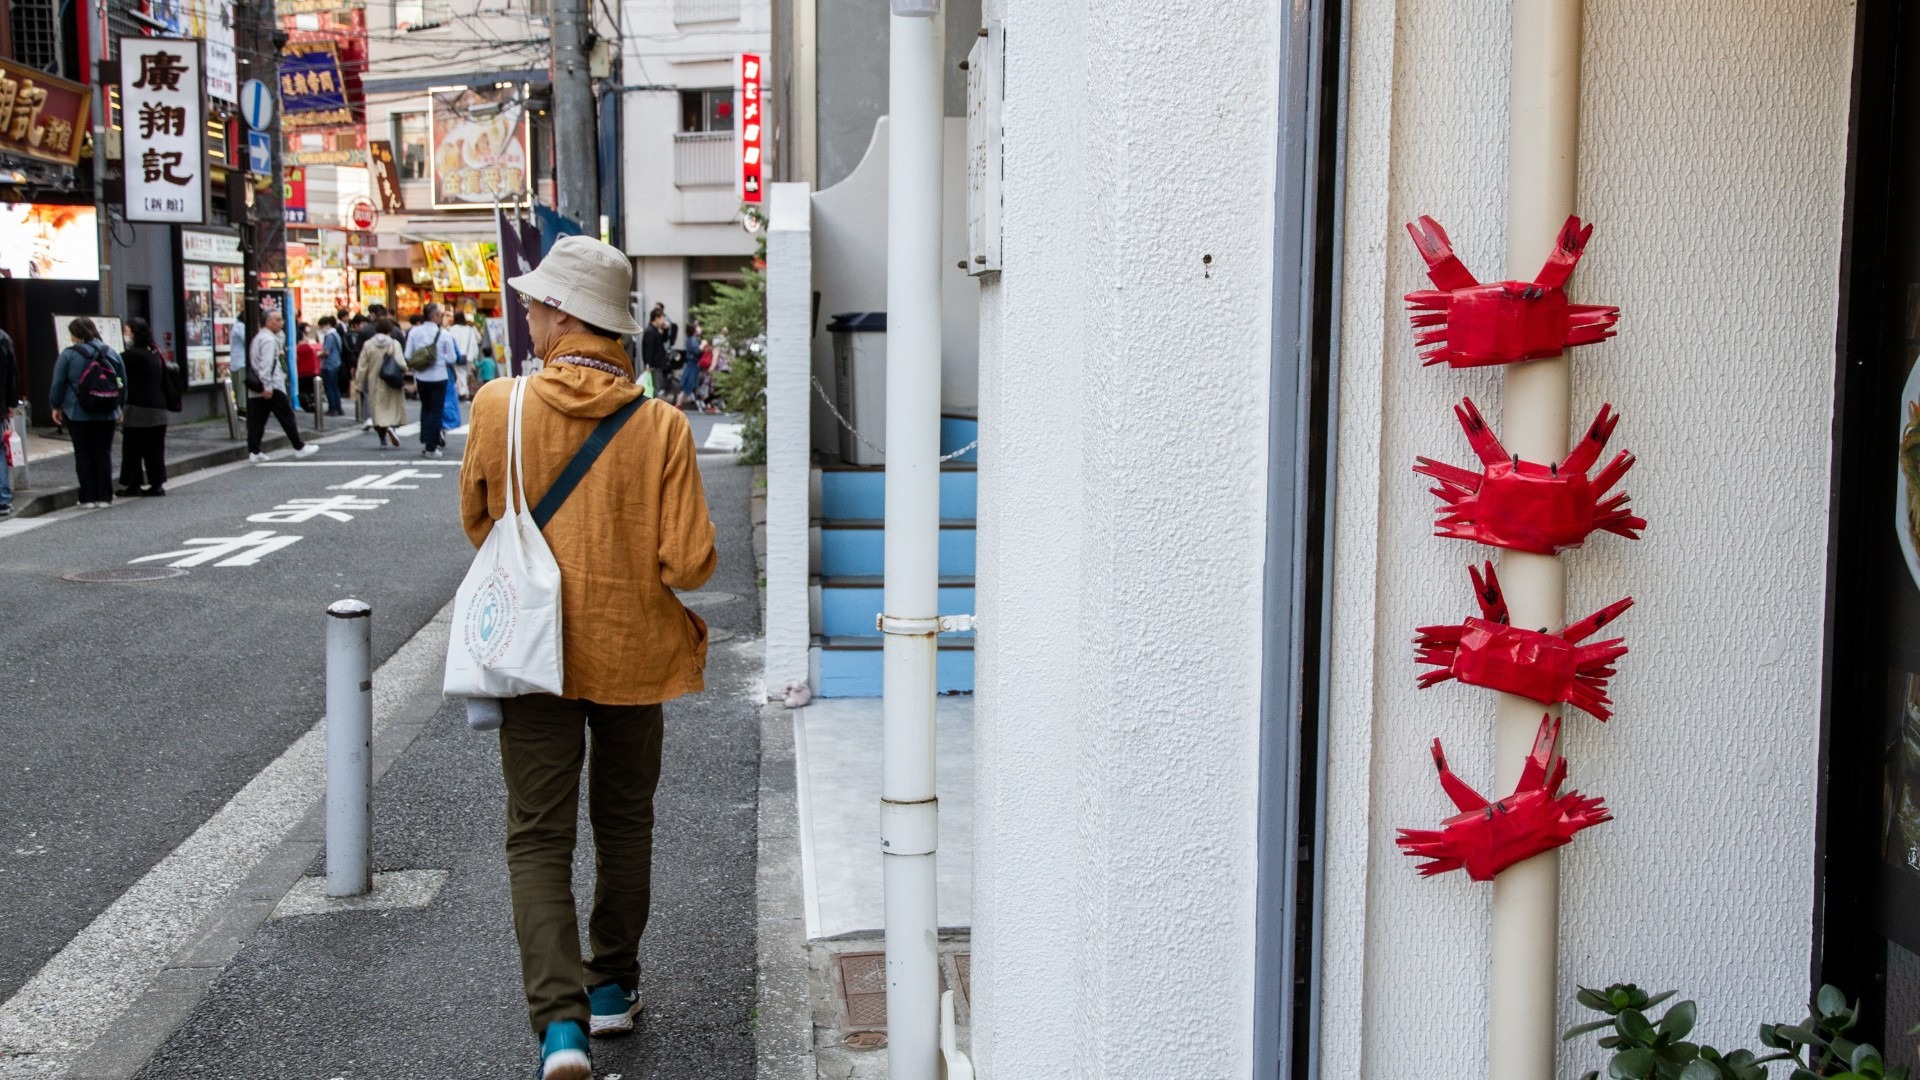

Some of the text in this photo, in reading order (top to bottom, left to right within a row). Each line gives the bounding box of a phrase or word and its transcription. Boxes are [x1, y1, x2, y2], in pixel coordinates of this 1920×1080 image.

[132, 50, 194, 186] 廣翔記
[127, 468, 443, 567] 止まれ
